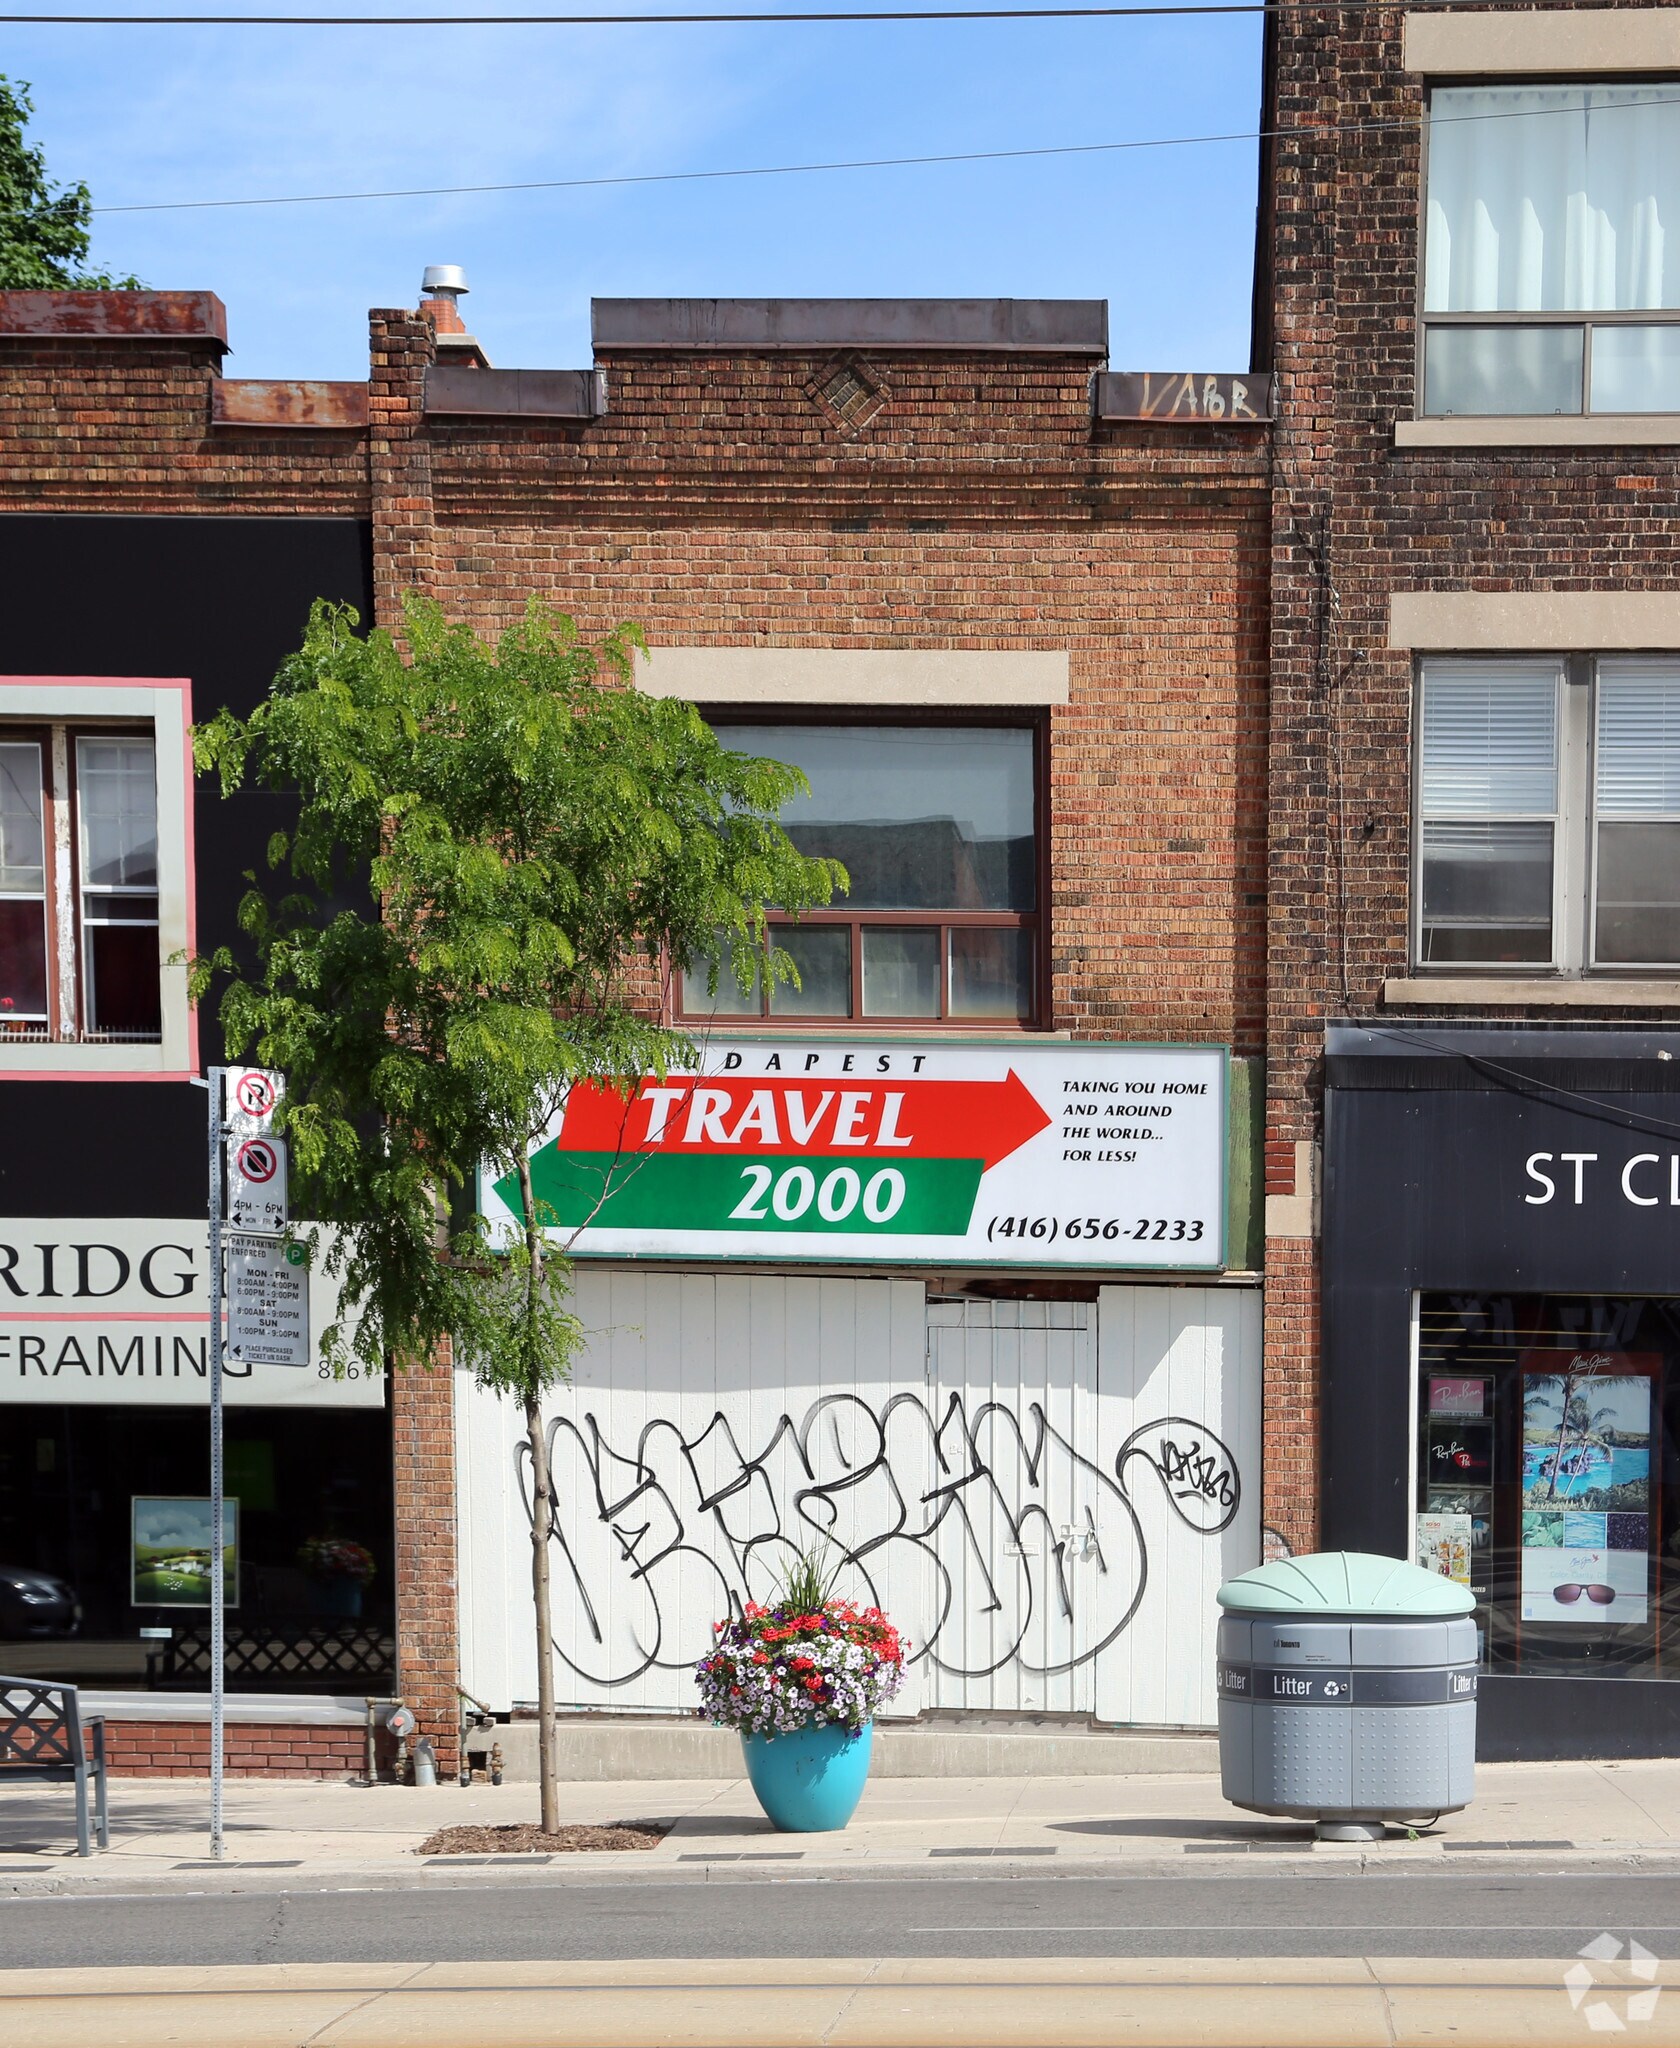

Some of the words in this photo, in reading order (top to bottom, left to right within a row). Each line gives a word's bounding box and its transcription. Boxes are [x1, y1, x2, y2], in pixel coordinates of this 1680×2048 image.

[646, 1051, 926, 1074] DAPEST
[1062, 1081, 1119, 1094] TAKING
[1124, 1082, 1155, 1095] YOU
[1161, 1083, 1208, 1095] HOME
[640, 1087, 915, 1147] TRAVEL
[1063, 1104, 1098, 1116] AND
[1103, 1104, 1172, 1117] AROUND
[1062, 1127, 1092, 1139] THE
[1096, 1127, 1164, 1140] WORLD...
[1063, 1150, 1092, 1162] FOR
[1097, 1150, 1137, 1163] LESS!
[1524, 1152, 1598, 1205] ST
[728, 1164, 906, 1224] 2000
[234, 1199, 252, 1211] 4PM
[265, 1202, 283, 1214] 6PM
[262, 1217, 271, 1225] FRI
[231, 1238, 245, 1246] PAY
[246, 1239, 277, 1250] PARKING
[231, 1248, 267, 1258] ENFORCED
[247, 1268, 267, 1278] MON
[275, 1271, 289, 1280] FRI
[237, 1277, 265, 1287] 8:00AM
[271, 1281, 299, 1290] 4:00PM
[237, 1287, 265, 1297] 6:00PM
[271, 1290, 299, 1300] 9:00PM
[260, 1299, 277, 1308] SAT
[237, 1307, 265, 1317] 8:00AM
[271, 1310, 299, 1319] 9:00PM
[259, 1318, 278, 1327] SUN
[238, 1326, 265, 1335] 1:00PM
[271, 1329, 299, 1339] 9:00PM
[245, 1344, 261, 1352] PLACE
[262, 1345, 293, 1355] PURCHASED
[248, 1352, 266, 1360] TICKET
[318, 1360, 359, 1380] 86
[1225, 1670, 1246, 1690] Litter
[1274, 1675, 1313, 1695] Litter
[1454, 1675, 1471, 1693] Litter
